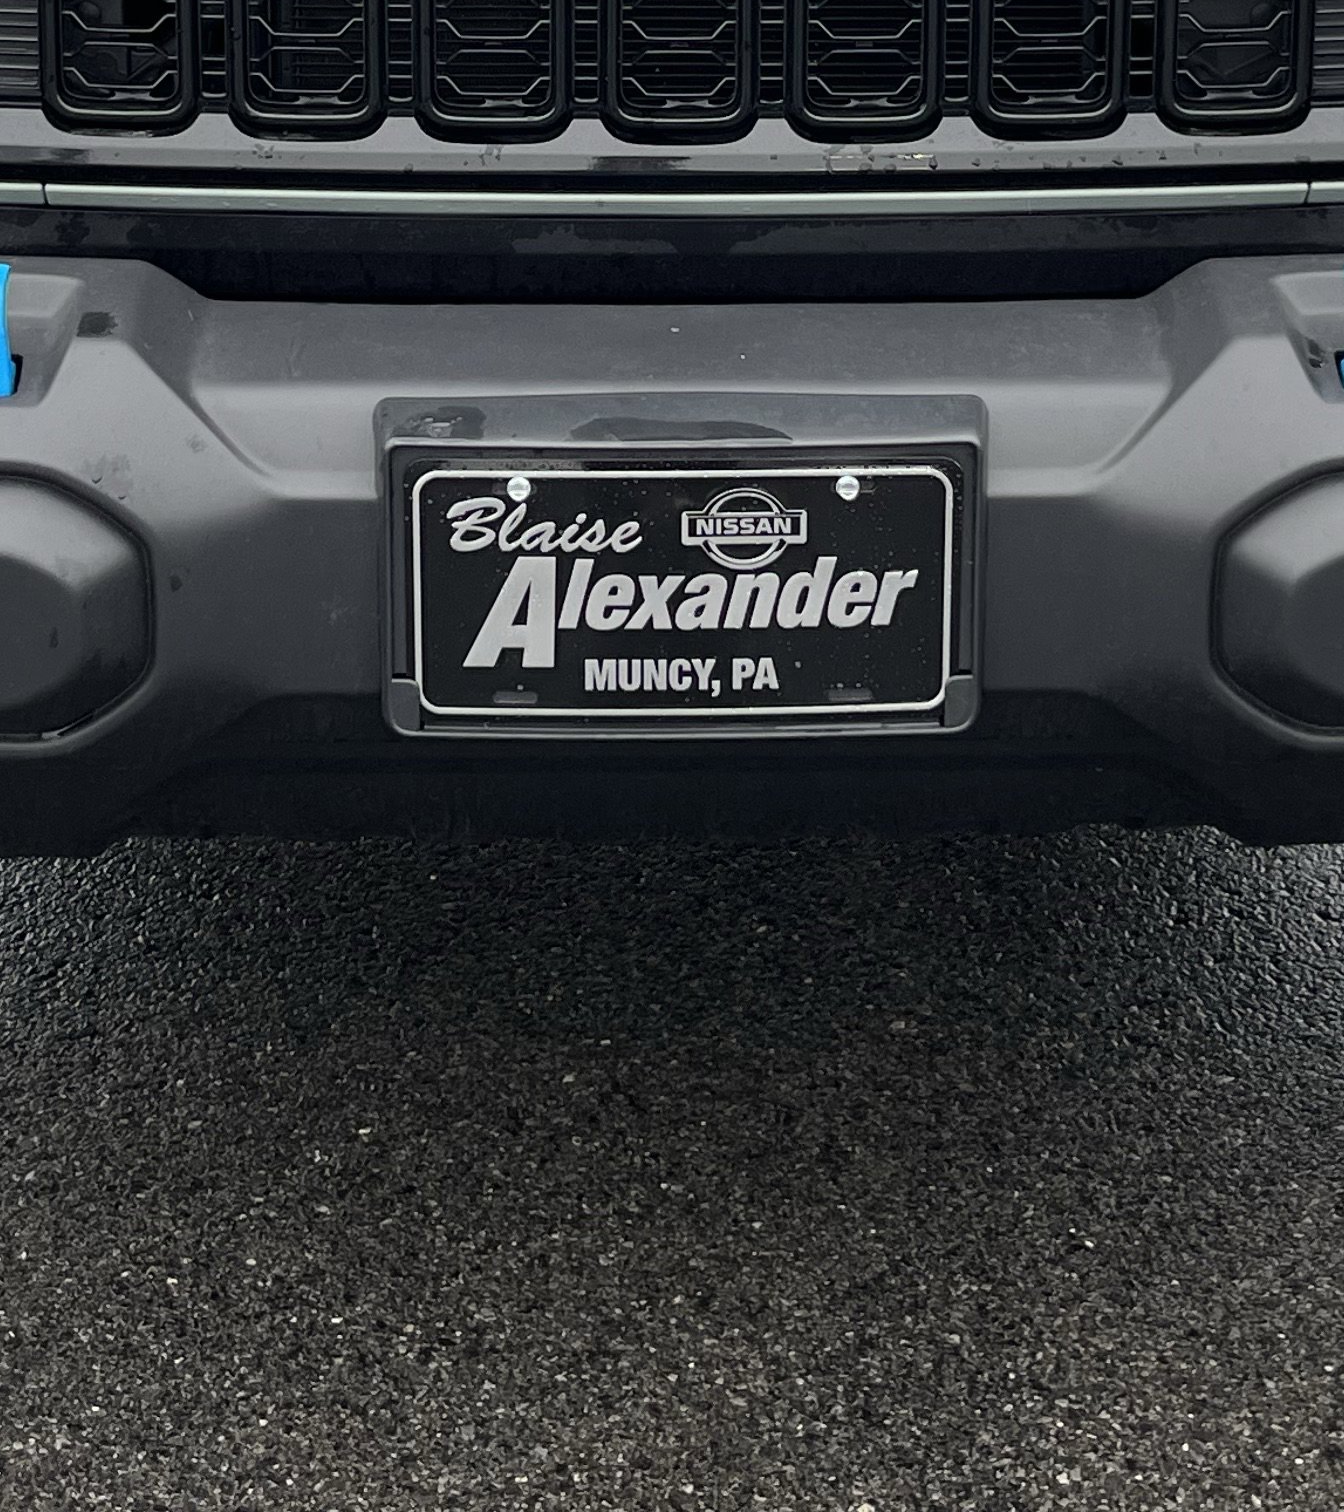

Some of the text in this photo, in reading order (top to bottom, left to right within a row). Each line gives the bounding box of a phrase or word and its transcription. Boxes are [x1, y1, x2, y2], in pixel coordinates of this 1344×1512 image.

[446, 497, 643, 553] Blaise
[695, 517, 793, 537] NISSAN
[462, 555, 919, 668] Alexander
[584, 657, 779, 697] MUNCY, PA
